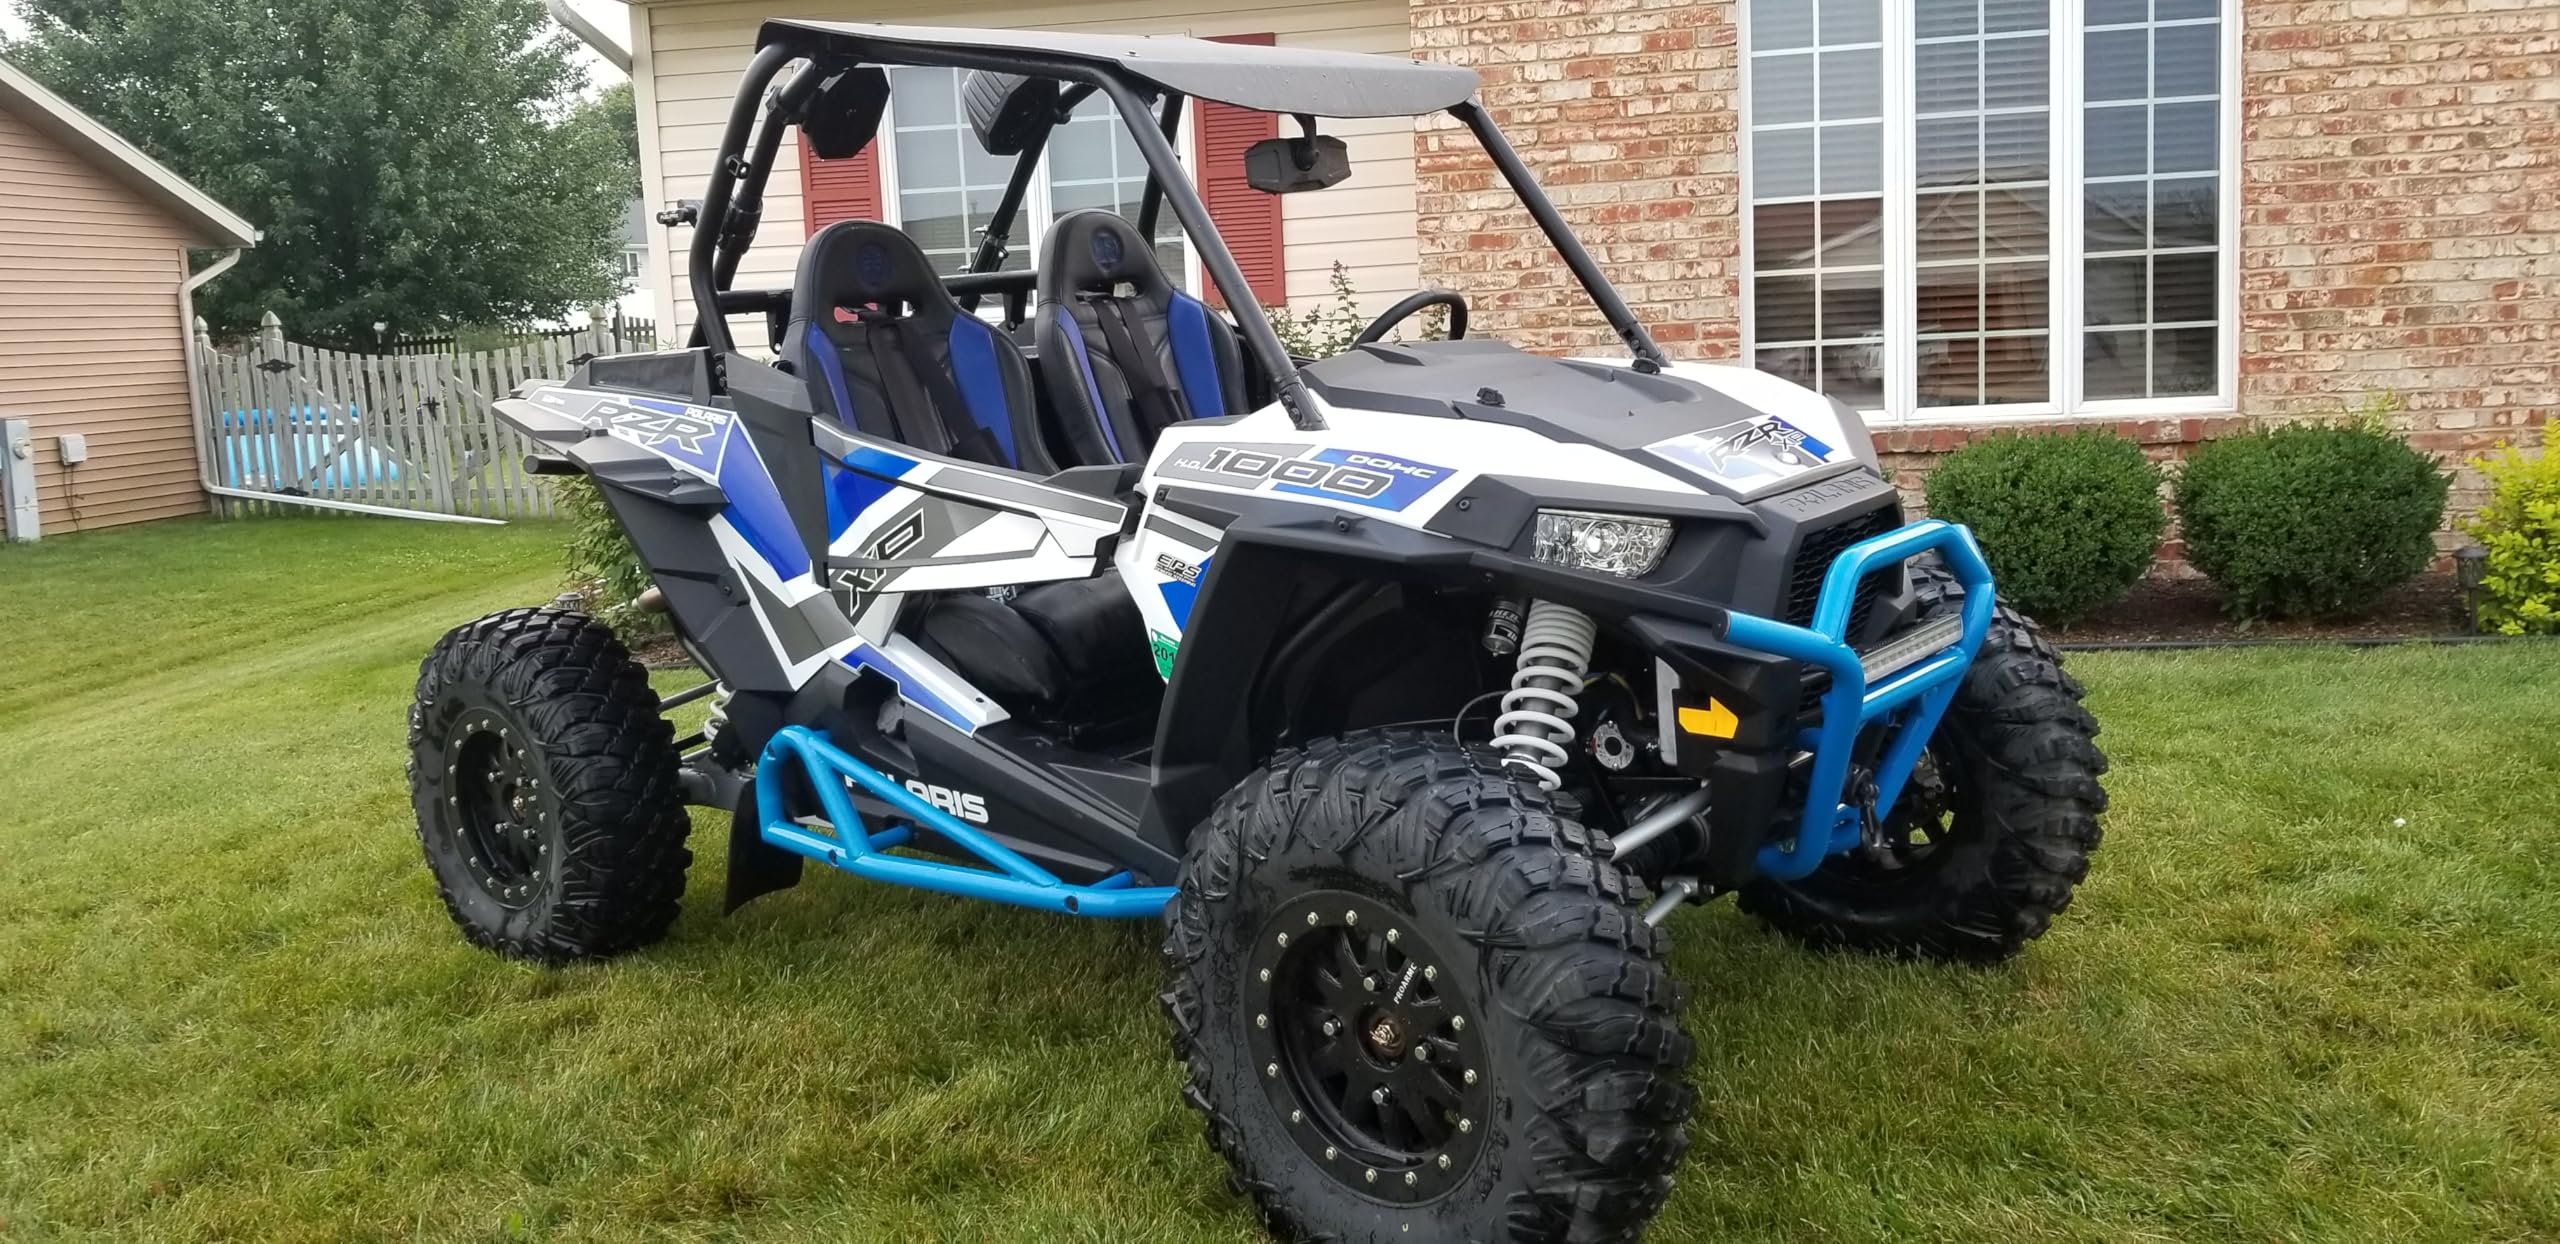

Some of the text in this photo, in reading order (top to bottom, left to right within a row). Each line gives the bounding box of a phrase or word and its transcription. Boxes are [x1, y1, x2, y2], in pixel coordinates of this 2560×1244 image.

[580, 399, 716, 455] RZR
[684, 406, 729, 425] POLARIS
[1200, 446, 1394, 499] 1000
[1346, 454, 1438, 479] DOHC
[1706, 421, 1794, 474] RZR
[1157, 552, 1202, 579] EPS
